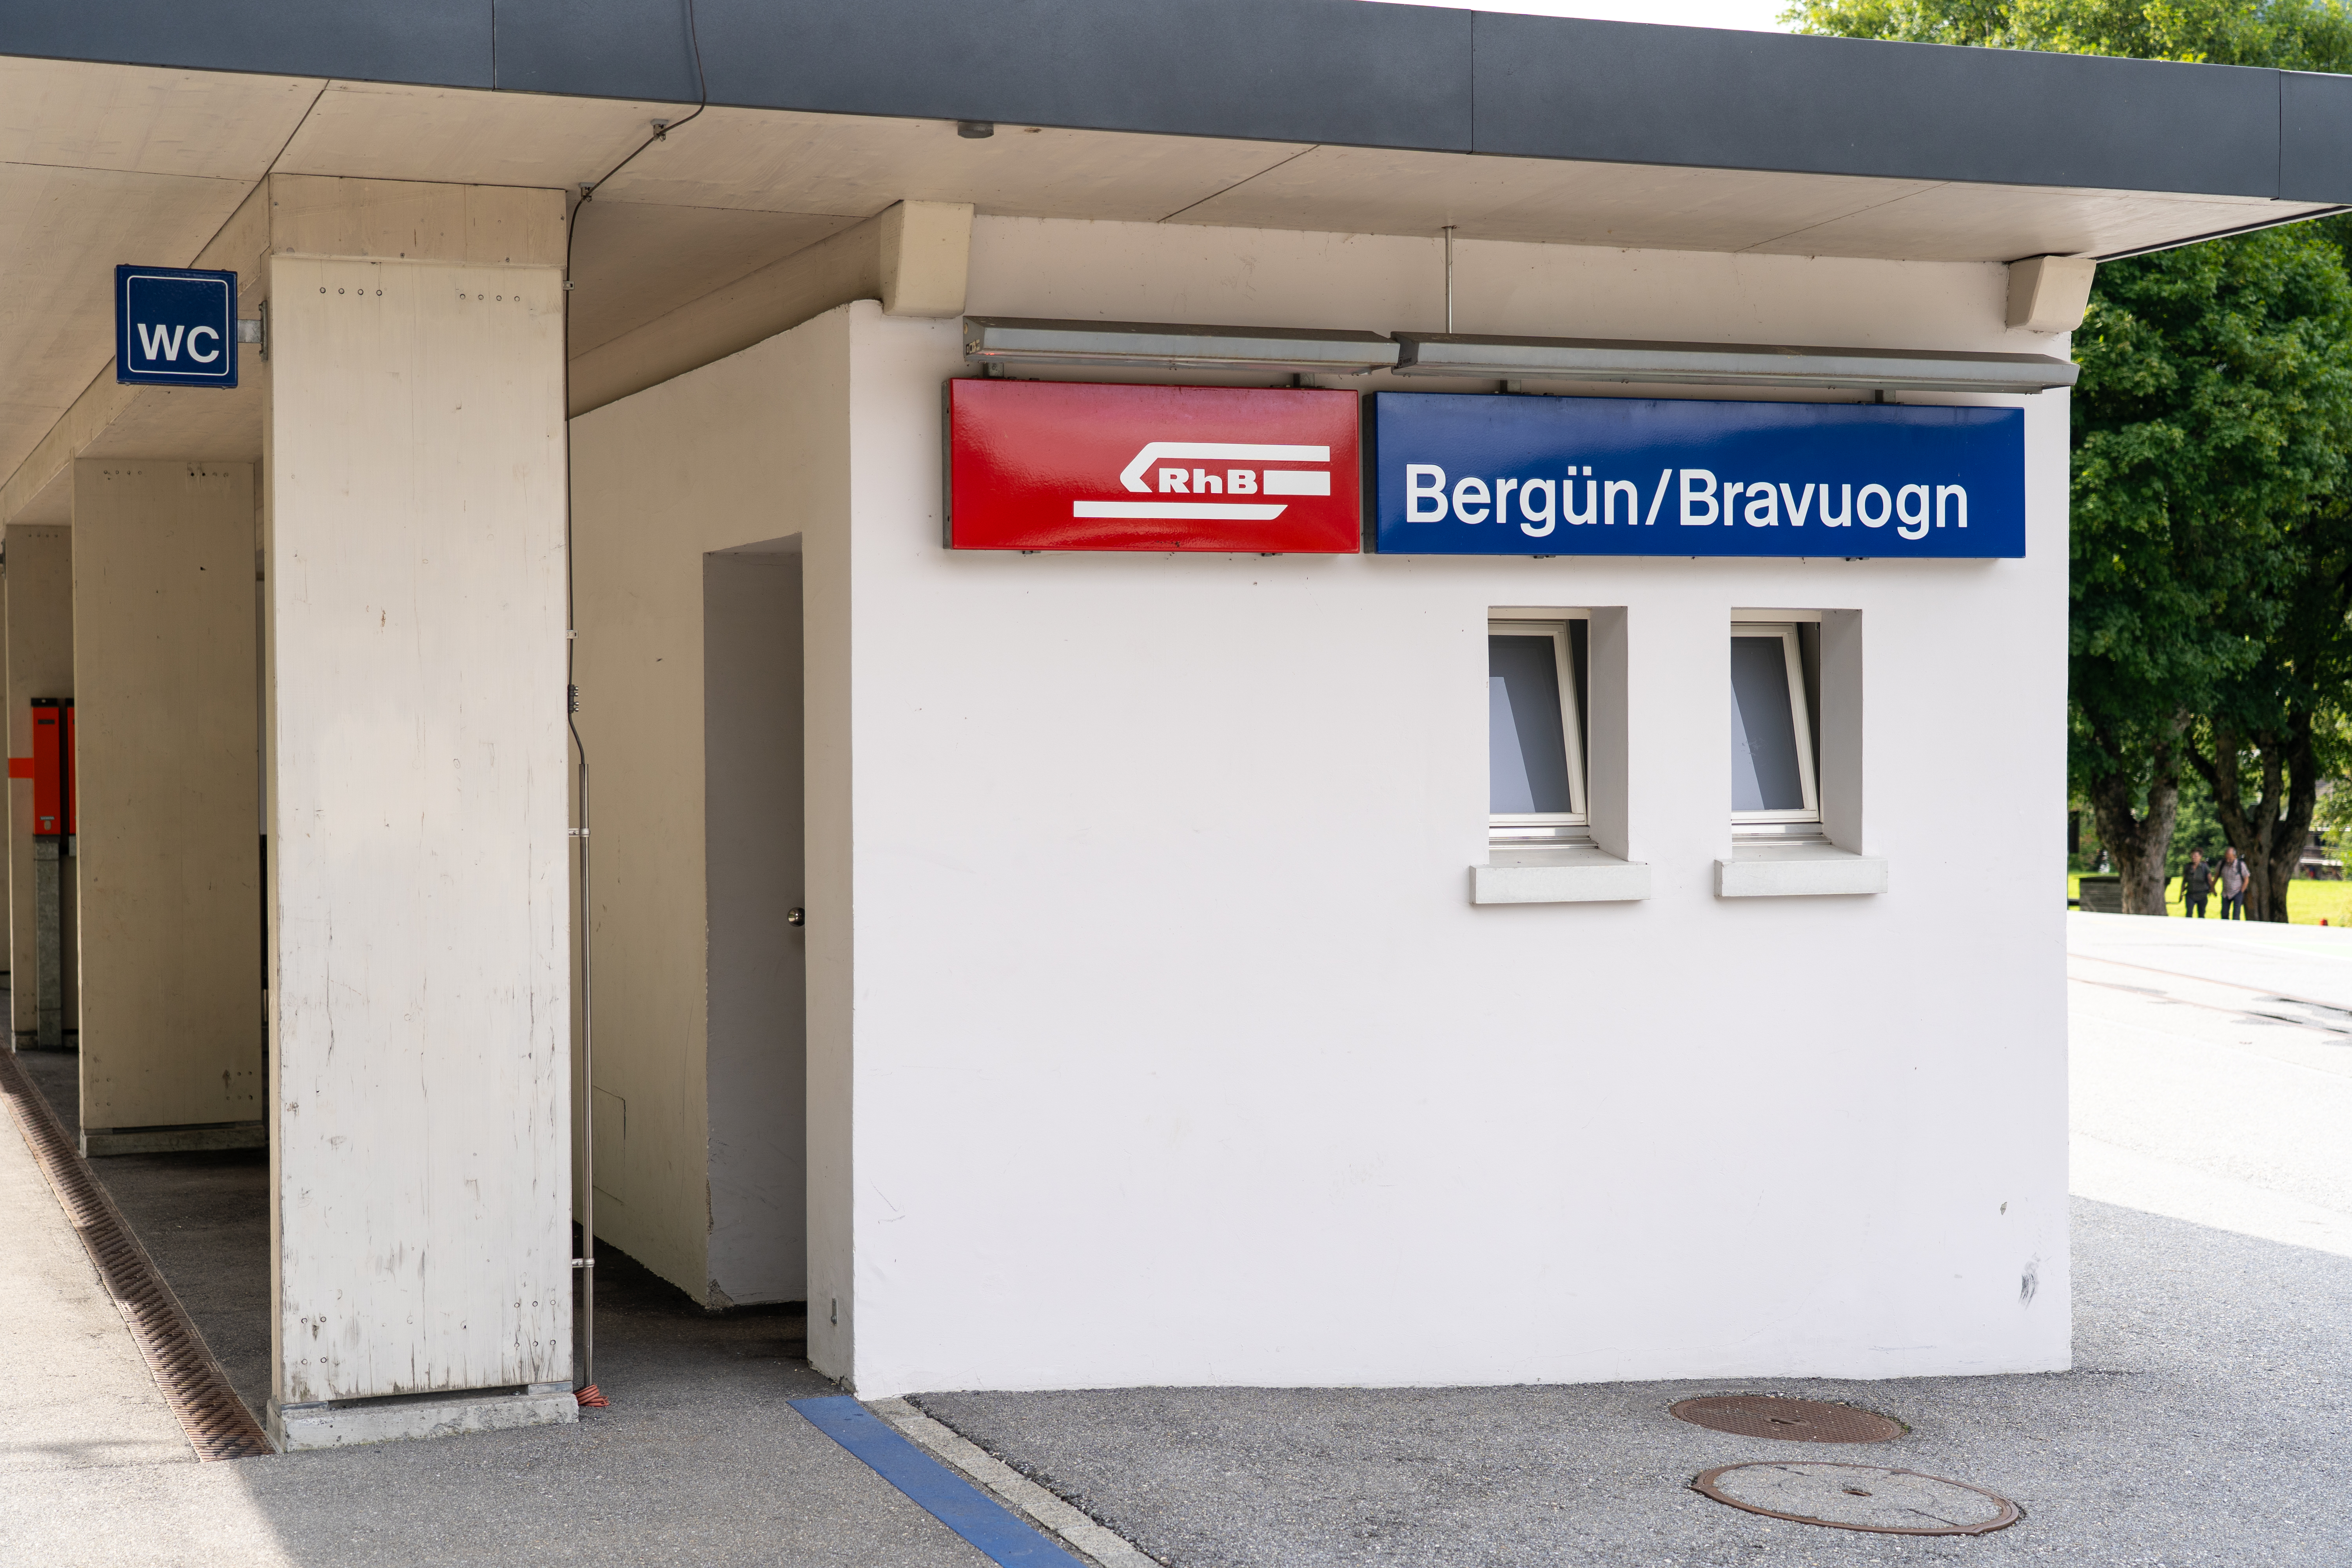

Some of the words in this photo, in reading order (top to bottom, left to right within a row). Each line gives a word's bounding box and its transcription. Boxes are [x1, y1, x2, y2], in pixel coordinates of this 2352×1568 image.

[137, 323, 219, 363] WC
[1159, 468, 1258, 494] RhB
[1406, 464, 1967, 540] Bergün/Bravuogn
